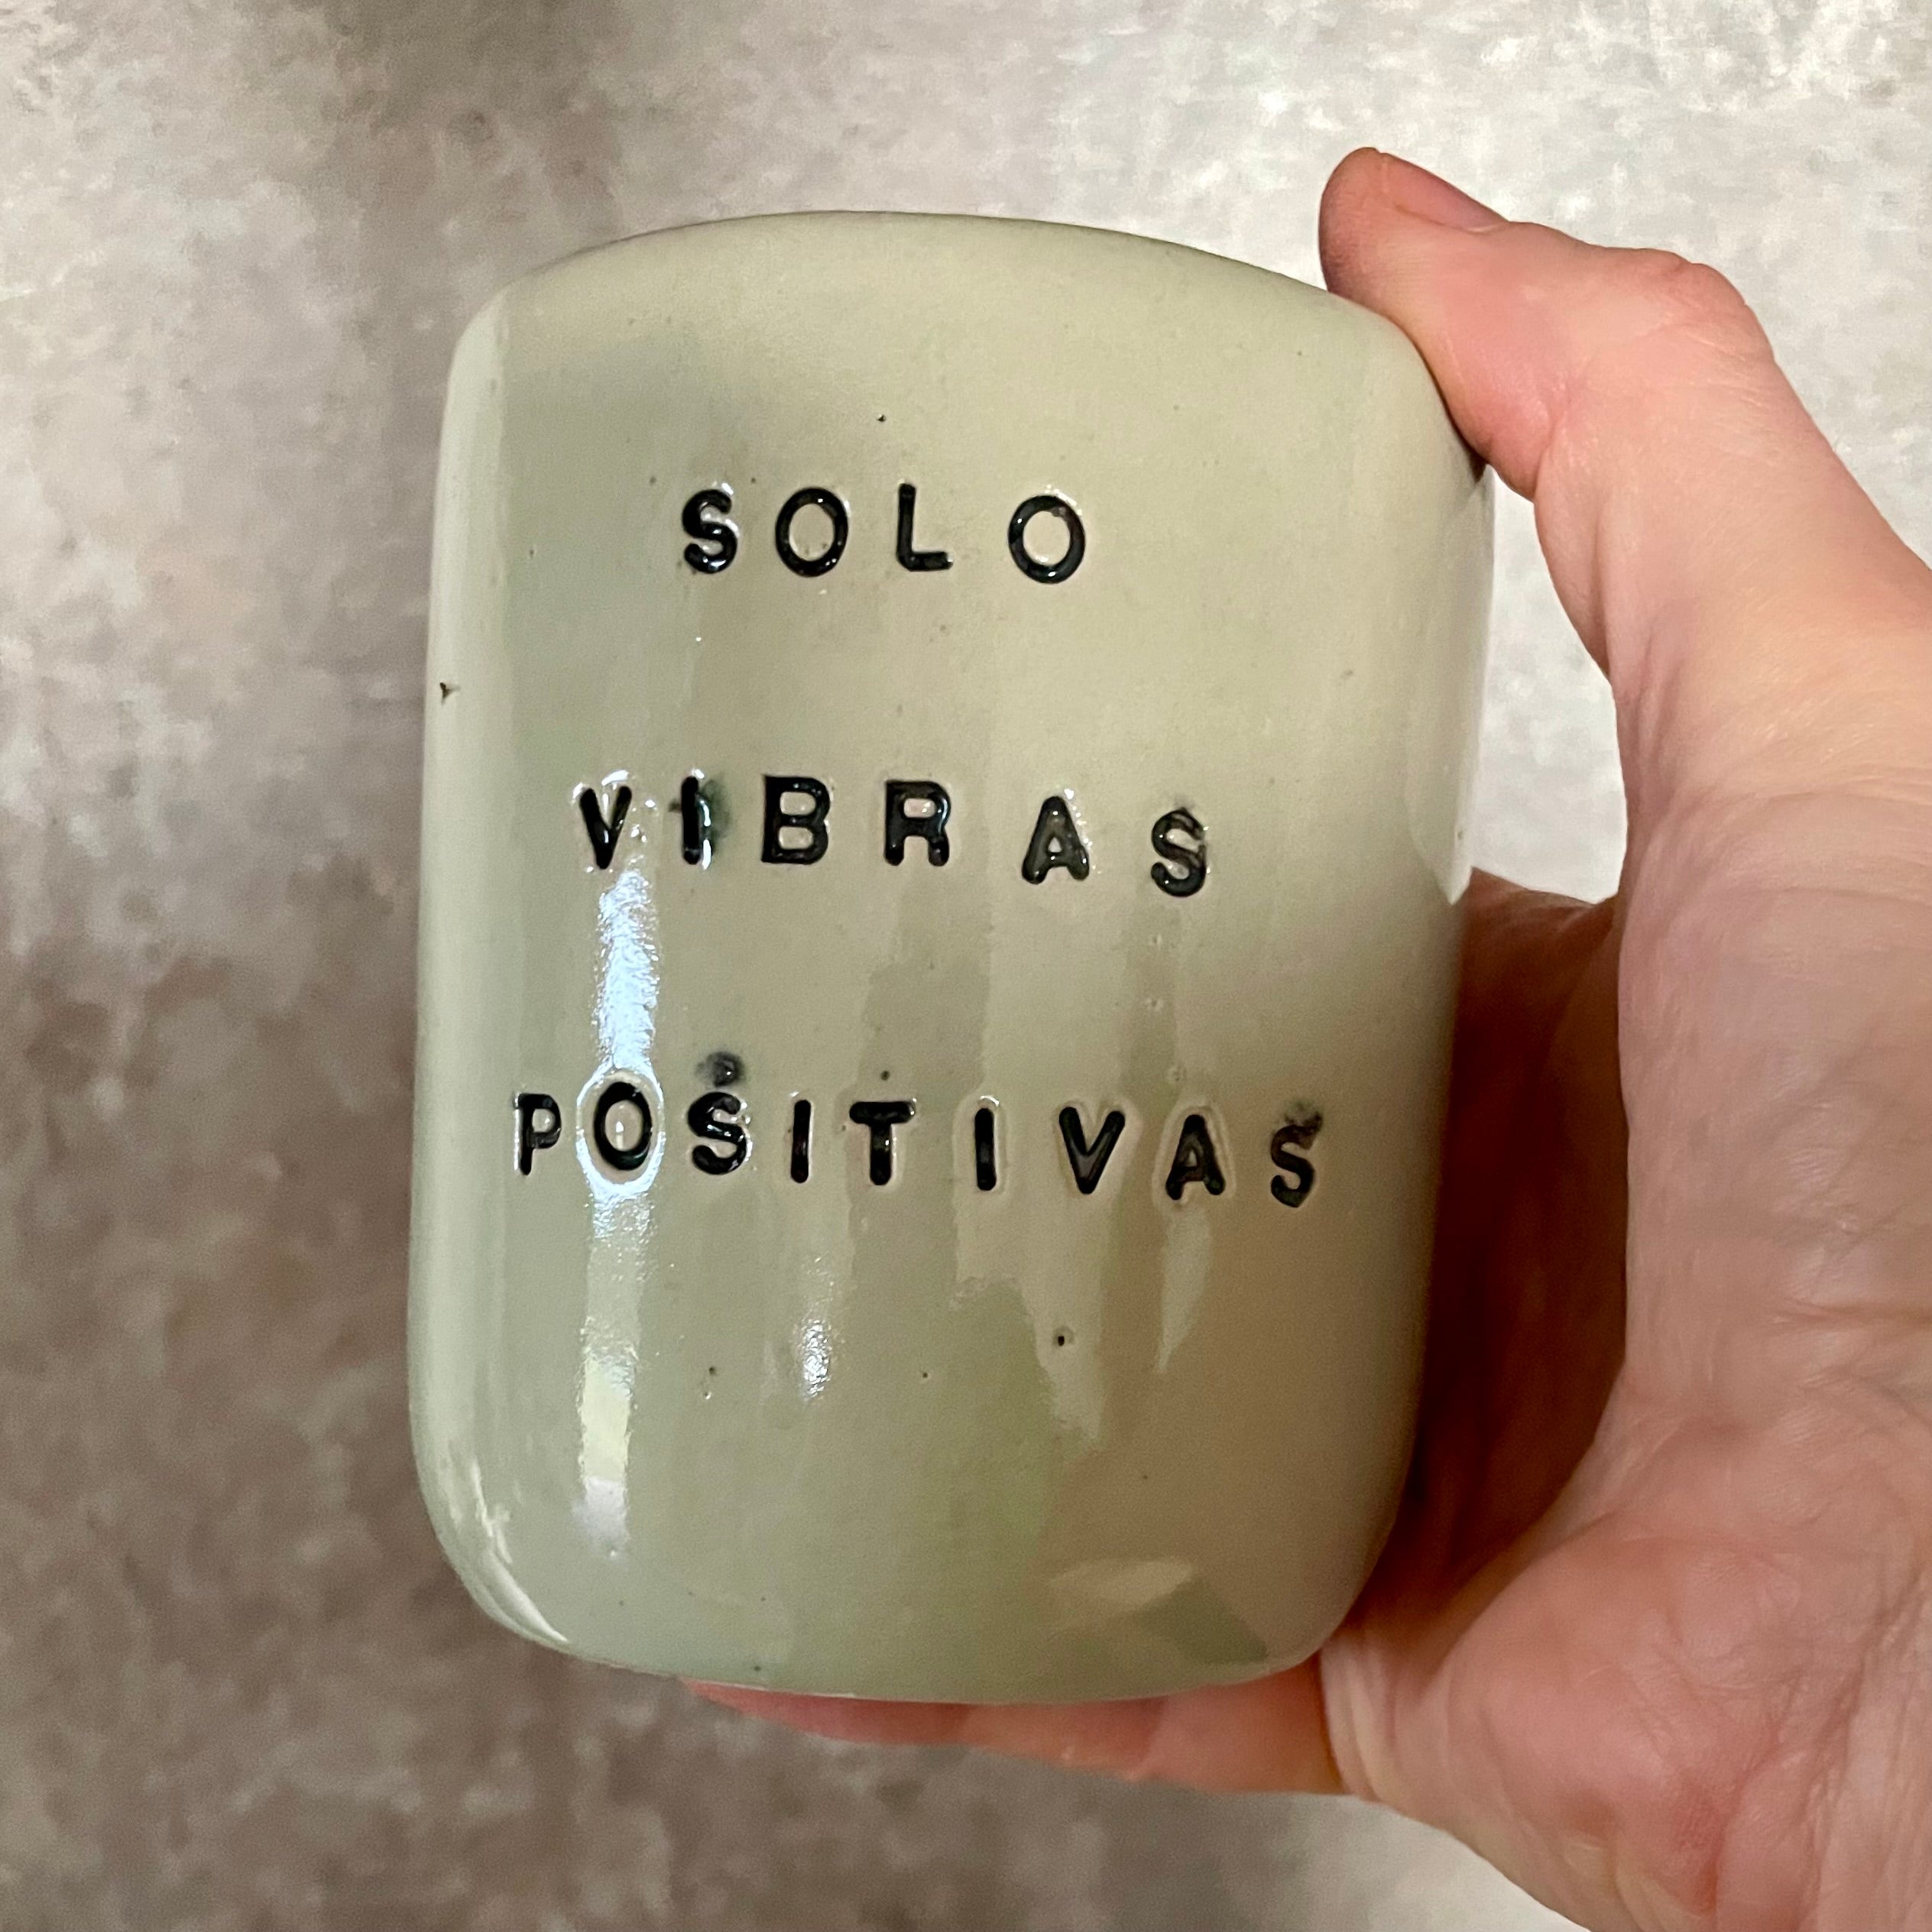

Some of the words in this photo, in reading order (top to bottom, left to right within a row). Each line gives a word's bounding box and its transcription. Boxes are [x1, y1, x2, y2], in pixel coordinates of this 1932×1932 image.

[681, 483, 1086, 584] SOLO
[578, 774, 1208, 898] VIBRAS
[514, 1081, 1323, 1208] POSITIVAS
